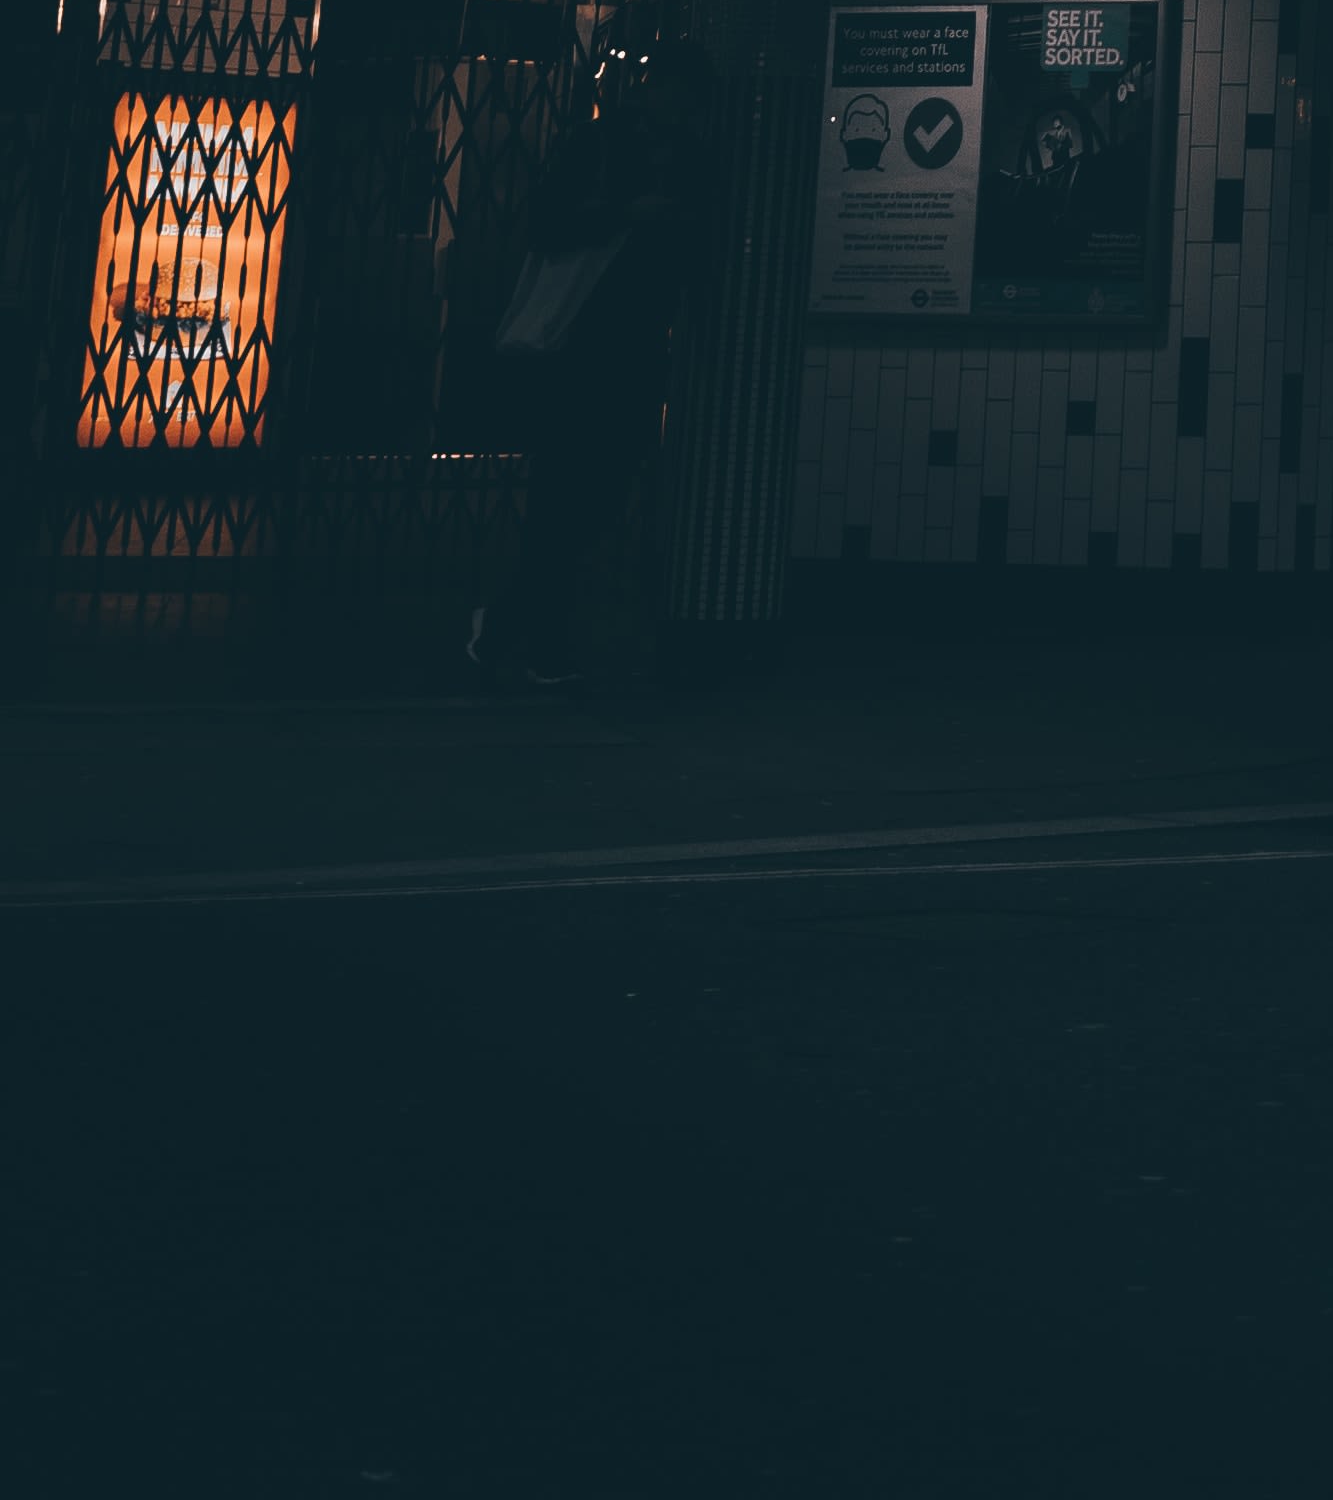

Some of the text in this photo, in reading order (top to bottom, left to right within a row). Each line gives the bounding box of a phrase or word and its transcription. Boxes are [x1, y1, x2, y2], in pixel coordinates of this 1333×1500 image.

[1047, 9, 1104, 28] SEE IT.
[843, 26, 969, 39] You must wear a face
[1046, 29, 1103, 47] SAY IT.
[859, 43, 949, 58] covering on TfL
[1044, 47, 1125, 65] SORTED.
[841, 60, 966, 74] services and stations
